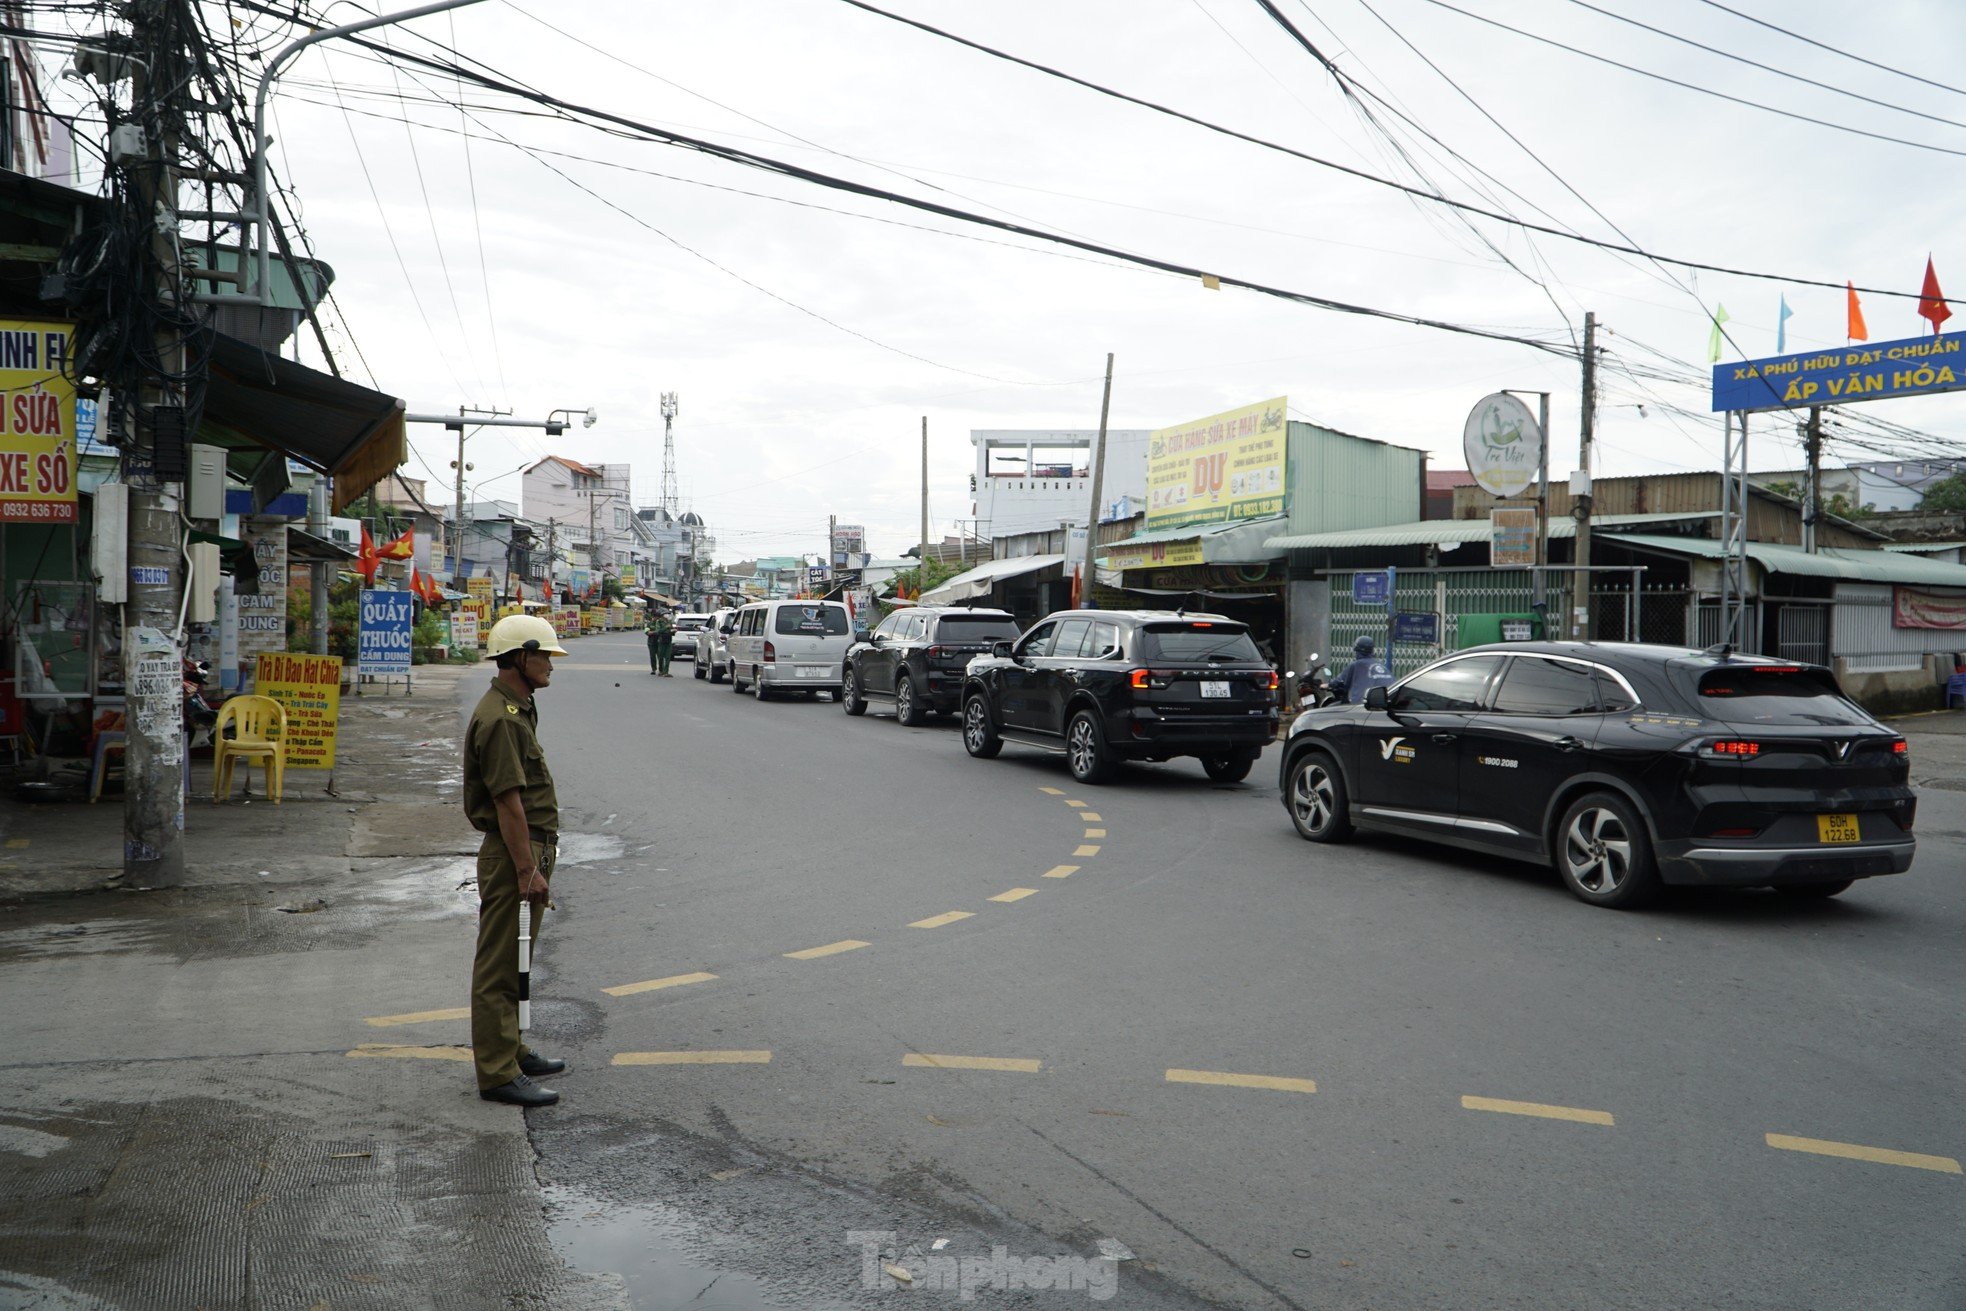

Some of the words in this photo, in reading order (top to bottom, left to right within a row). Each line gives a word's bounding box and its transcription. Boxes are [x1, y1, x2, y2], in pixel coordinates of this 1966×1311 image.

[1763, 357, 1799, 376] PHÚ
[1802, 354, 1841, 371] HỮU
[1845, 349, 1883, 366] ĐẠT
[1887, 335, 1960, 360] CHUẨN
[1782, 375, 1819, 402] ẤP
[1827, 372, 1884, 396] VĂN
[1892, 361, 1957, 389] HÓA
[13, 382, 62, 435] SỬA
[0, 453, 29, 493] XE
[37, 441, 69, 494] SỐ
[3, 503, 29, 517] 0932
[31, 503, 50, 517] 636
[52, 504, 72, 518] 730
[360, 623, 410, 649] THUỐC
[384, 651, 410, 661] DUNG
[258, 655, 273, 681] Trà
[274, 656, 285, 682] Bí
[320, 658, 340, 685] Chia
[301, 729, 320, 737] Khoai
[1484, 756, 1501, 766] 1900
[1500, 758, 1519, 769] 2088
[1829, 815, 1848, 828] 60H
[1825, 828, 1857, 842] 122.68
